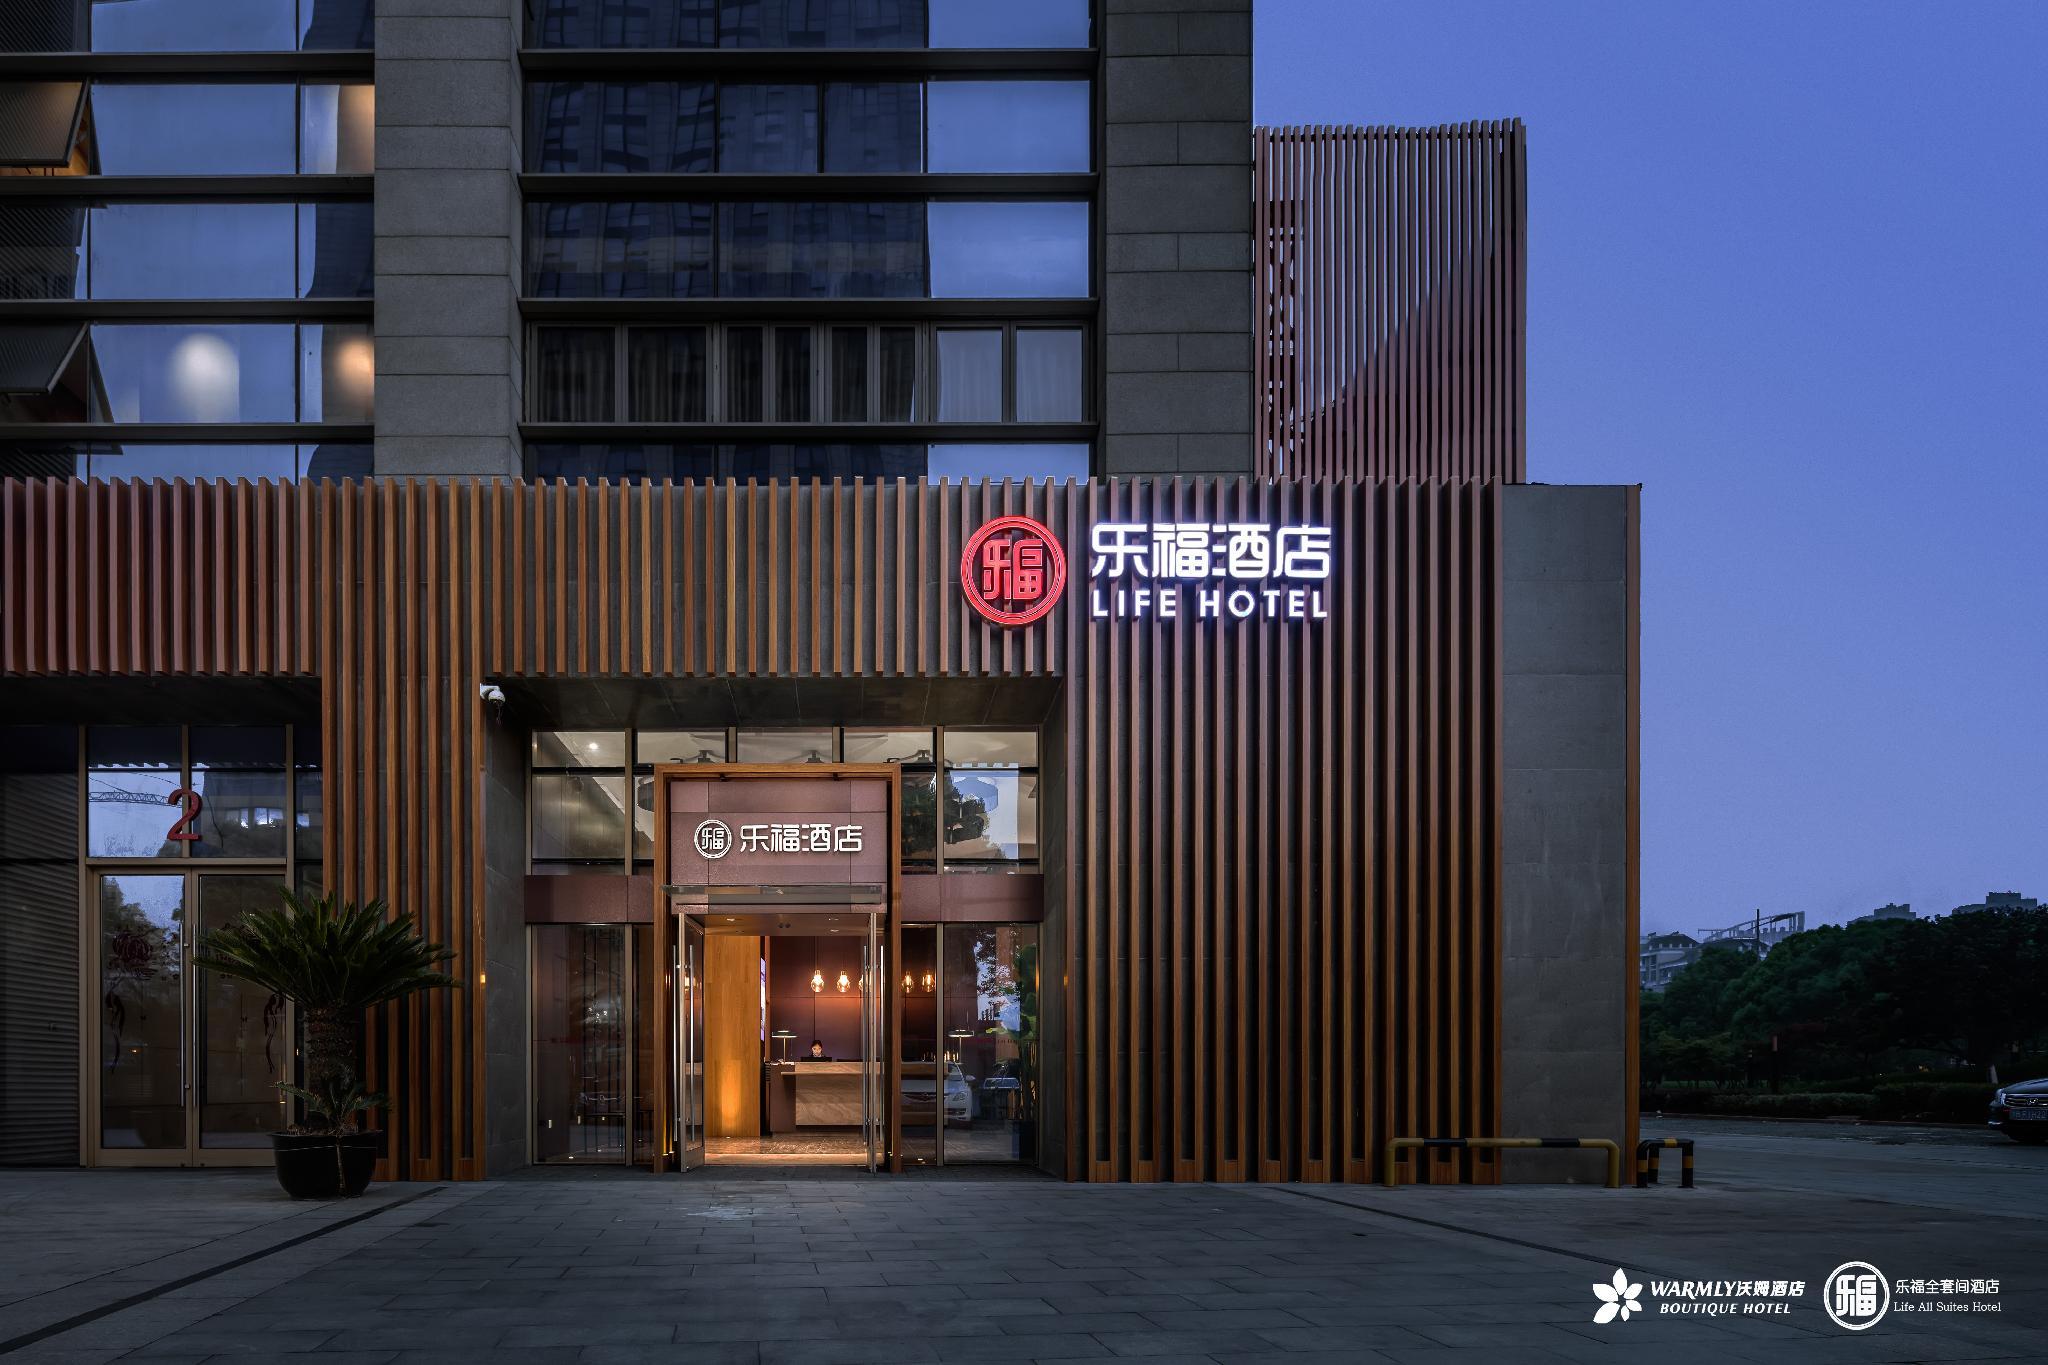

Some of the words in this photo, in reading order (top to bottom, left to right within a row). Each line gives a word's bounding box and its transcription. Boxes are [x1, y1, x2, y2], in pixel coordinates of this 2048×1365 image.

[1091, 523, 1331, 579] 乐福酒店
[1093, 590, 1177, 618] LIFE
[1199, 590, 1328, 618] HOTEL
[167, 788, 202, 840] 2
[740, 823, 863, 853] 乐福酒店
